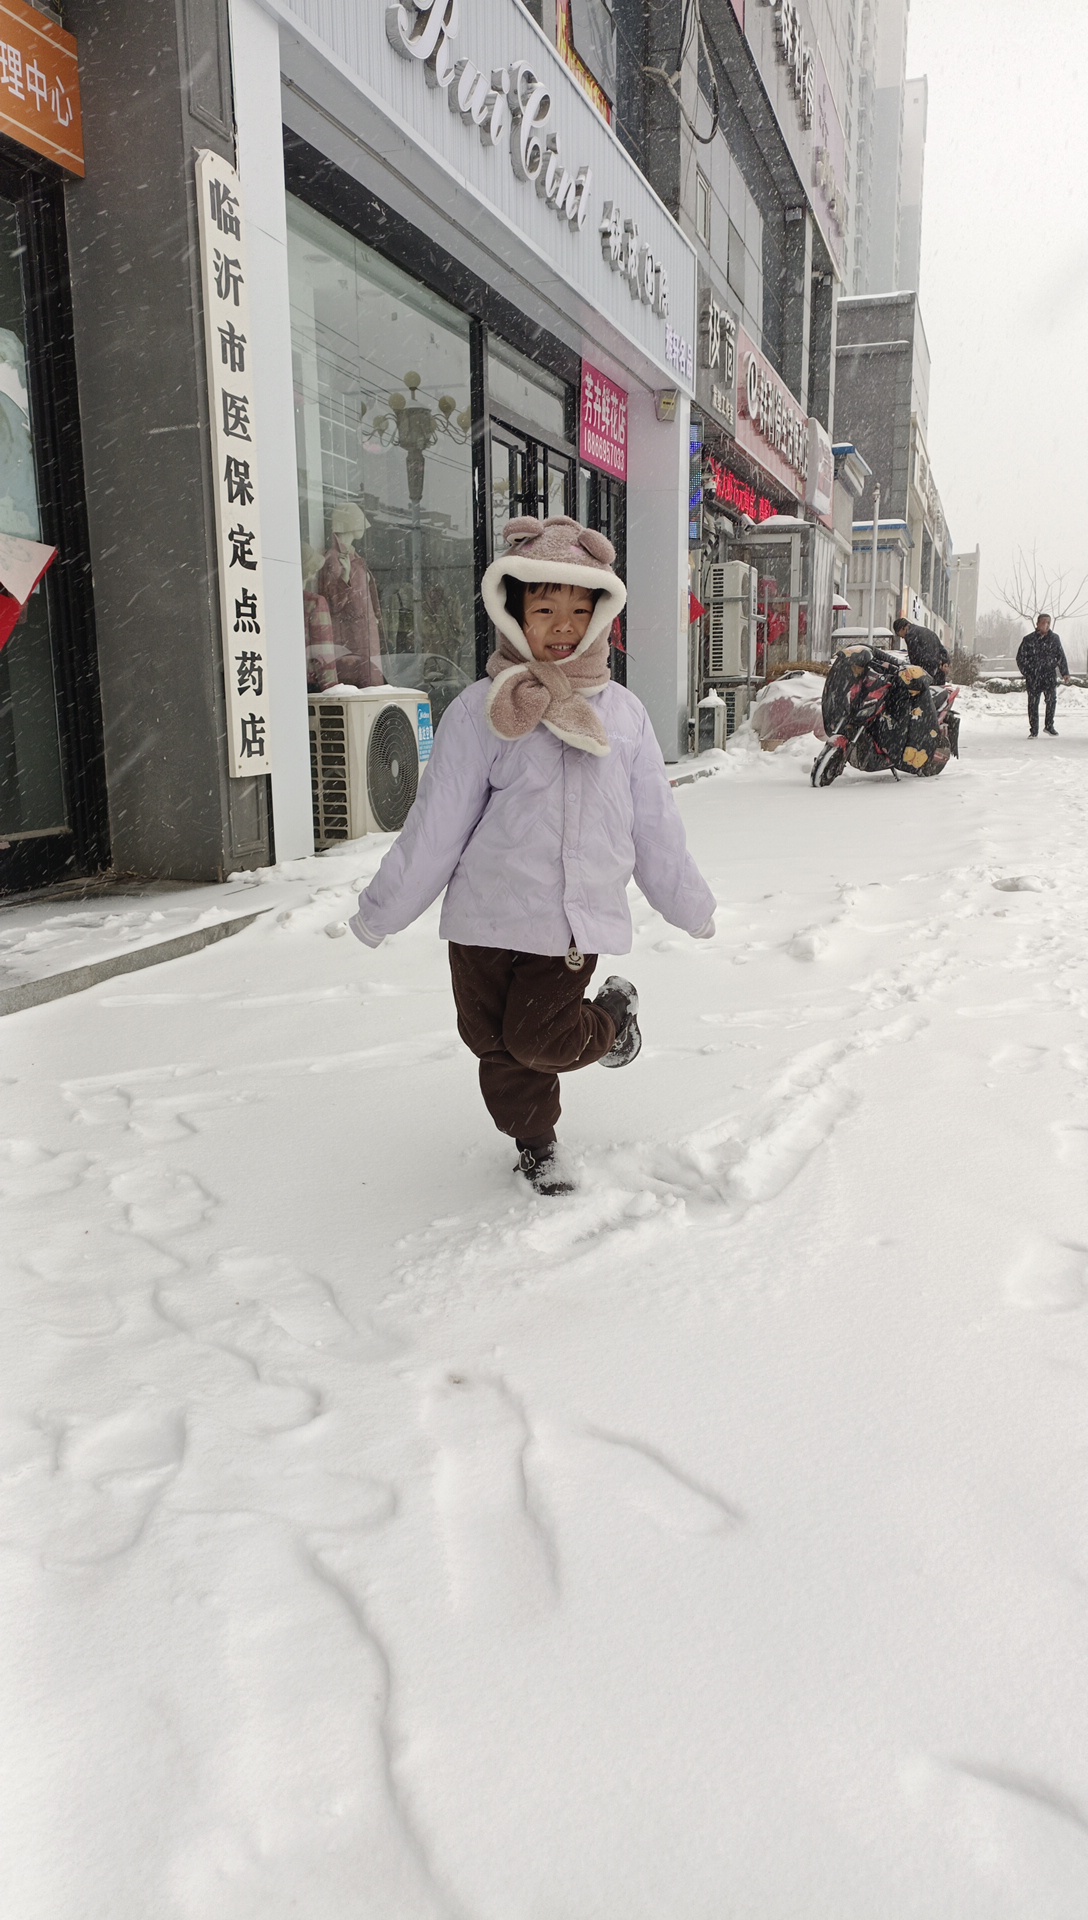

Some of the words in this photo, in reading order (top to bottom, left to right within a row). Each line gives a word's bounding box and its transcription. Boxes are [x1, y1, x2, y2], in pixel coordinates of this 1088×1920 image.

[208, 178, 266, 758] 临沂市医保定点药店
[584, 372, 626, 444] 芳卉鲜花店
